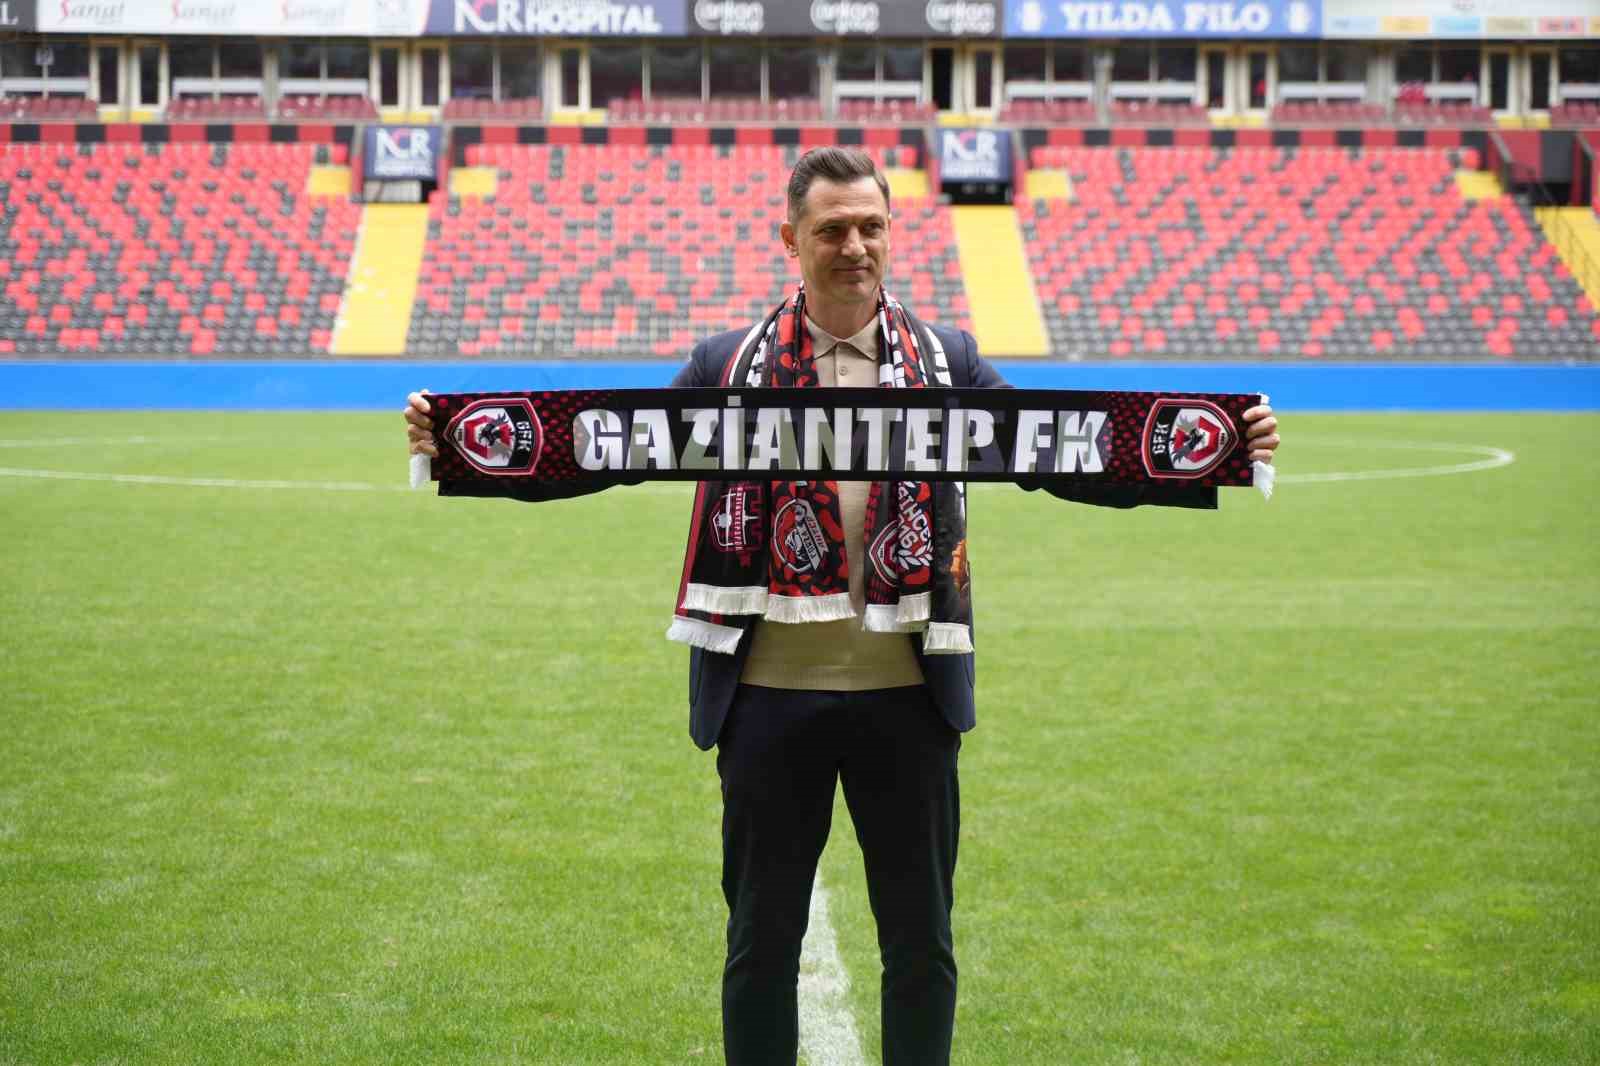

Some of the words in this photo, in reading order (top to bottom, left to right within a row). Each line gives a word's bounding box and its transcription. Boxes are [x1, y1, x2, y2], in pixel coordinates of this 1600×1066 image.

[526, 6, 662, 33] HOSPITAL
[1061, 2, 1175, 31] YILDA
[376, 127, 431, 160] NCR
[943, 131, 998, 161] NCR
[573, 395, 995, 473] GAZİANTEP
[1014, 409, 1108, 474] FK
[1152, 421, 1169, 455] GFK
